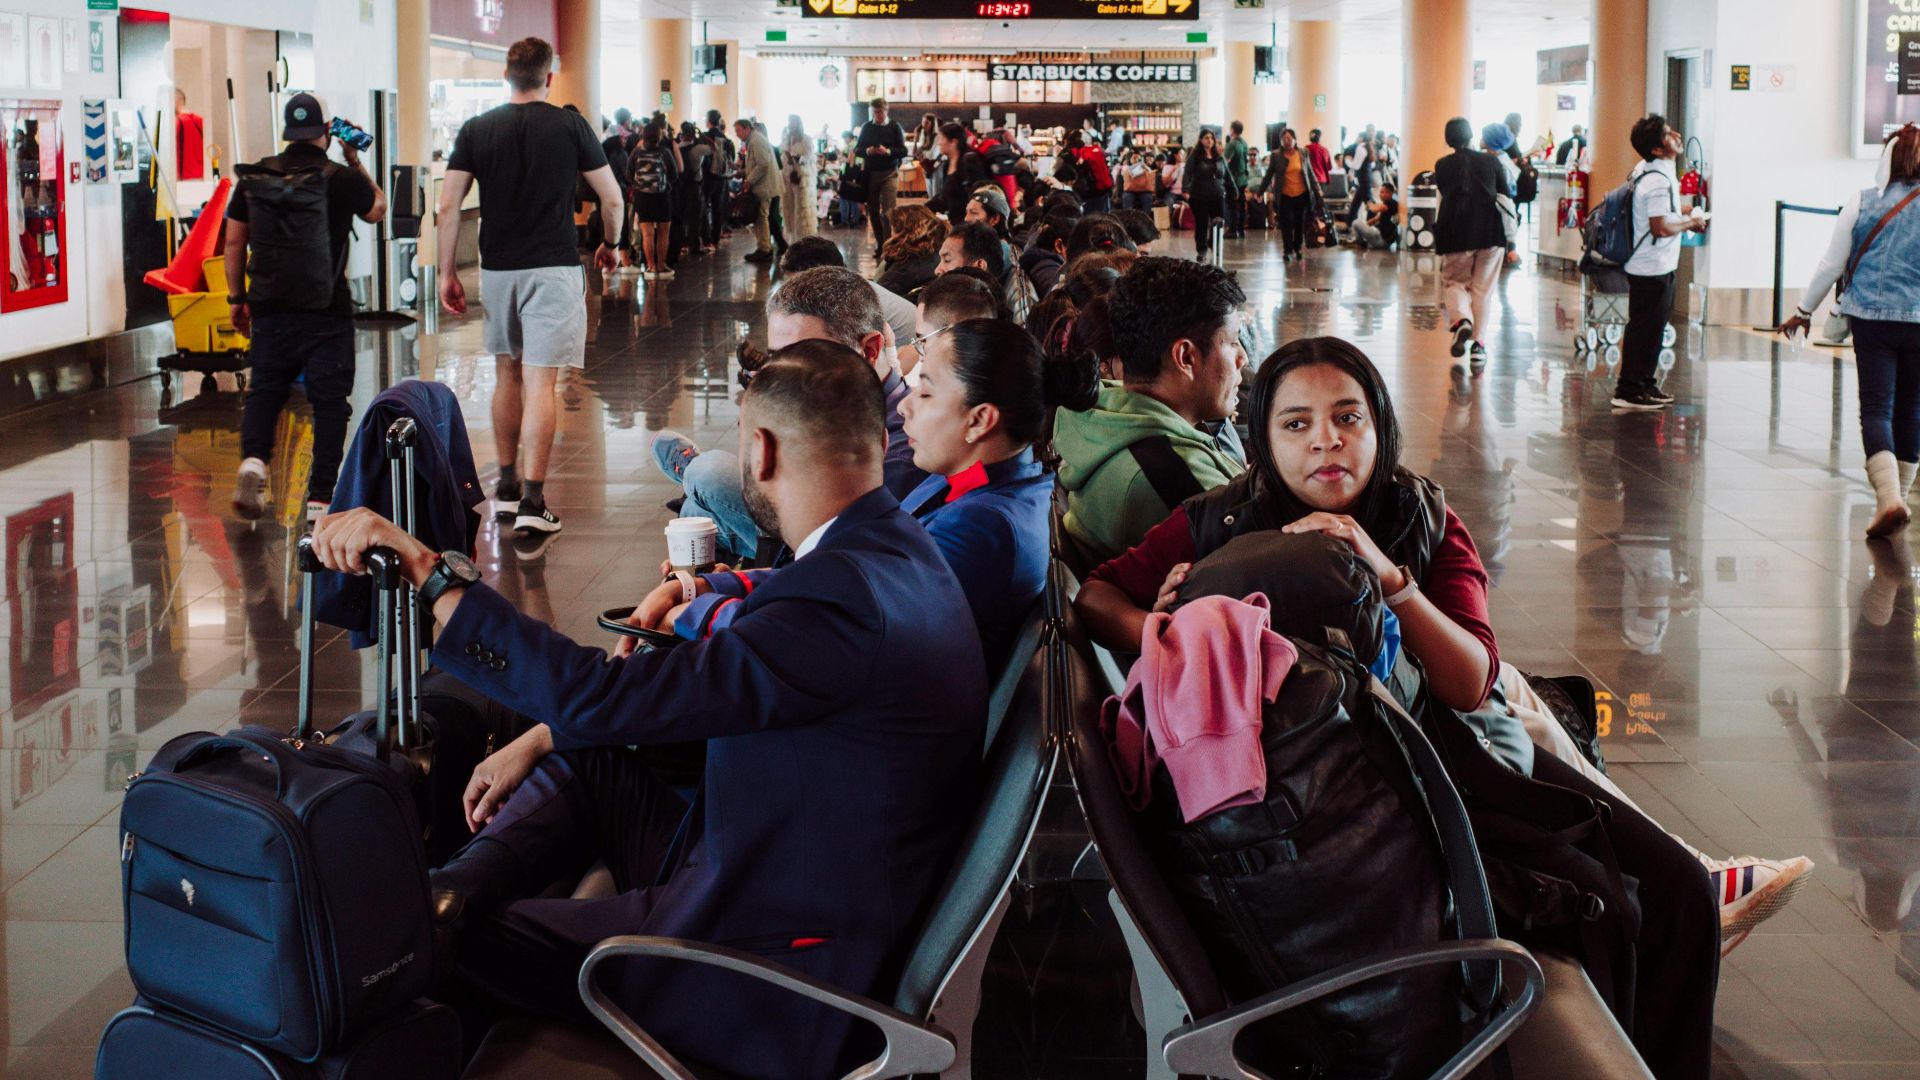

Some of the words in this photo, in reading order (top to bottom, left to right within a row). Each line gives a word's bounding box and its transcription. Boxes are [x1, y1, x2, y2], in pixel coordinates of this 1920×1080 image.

[858, 4, 879, 14] Gates
[879, 4, 898, 14] 9-12
[979, 3, 1030, 16] 11:34:27
[1097, 4, 1117, 14] Gates
[993, 65, 1112, 81] STARBUCKS
[1115, 65, 1191, 81] COFFEE
[361, 952, 415, 988] Samsonite
